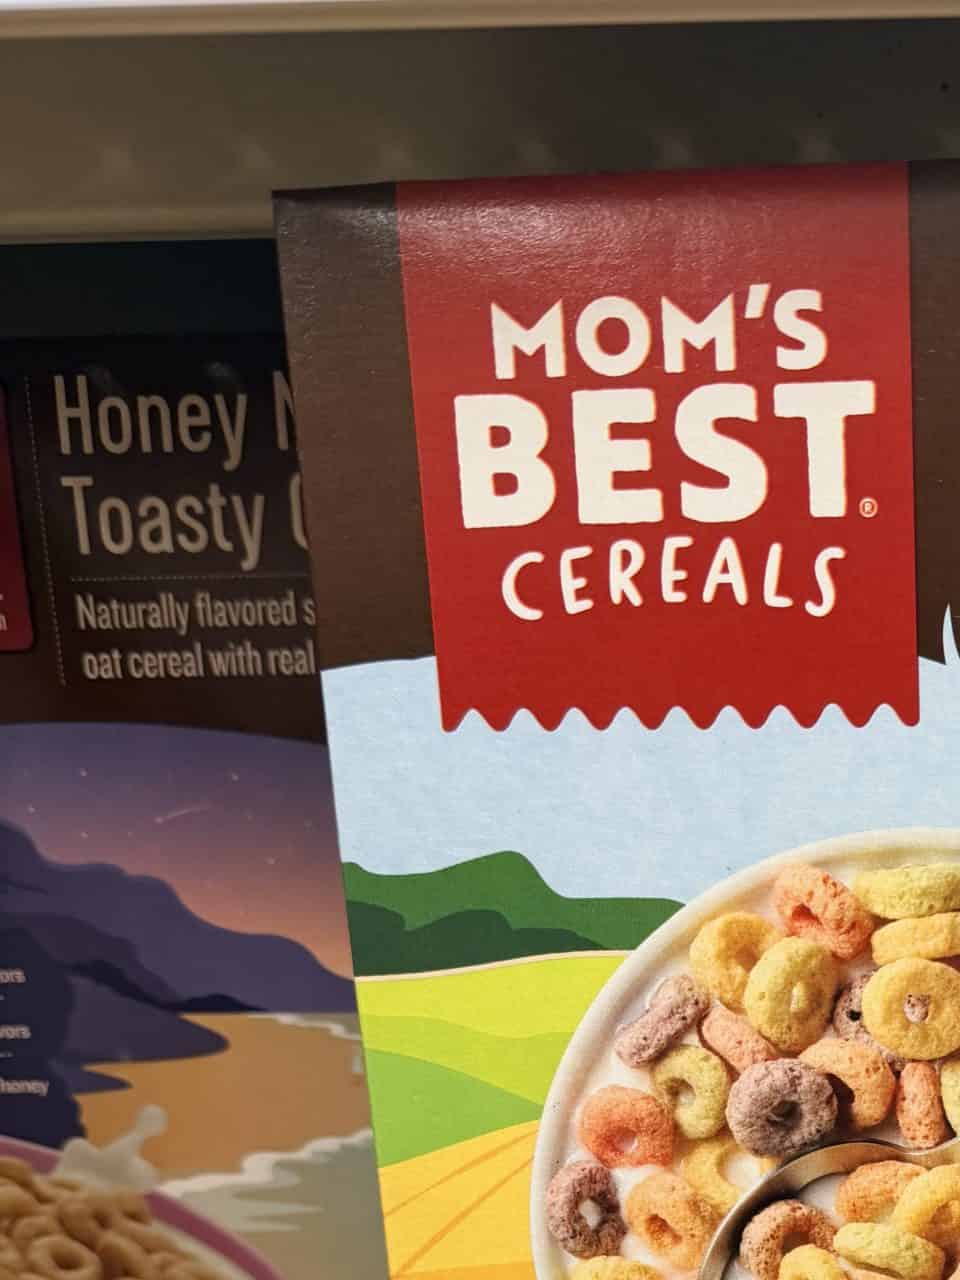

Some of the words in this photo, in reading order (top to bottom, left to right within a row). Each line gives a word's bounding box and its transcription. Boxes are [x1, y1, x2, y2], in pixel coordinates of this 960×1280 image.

[490, 283, 827, 380] MOM'S
[54, 374, 248, 472] Honey
[60, 475, 265, 572] Toasty
[75, 592, 189, 637] Naturally
[196, 589, 298, 628] flavored
[501, 536, 846, 621] CEREALS
[83, 648, 123, 680] oat
[128, 642, 203, 678] cereal
[209, 641, 264, 677] with
[269, 639, 316, 675] real
